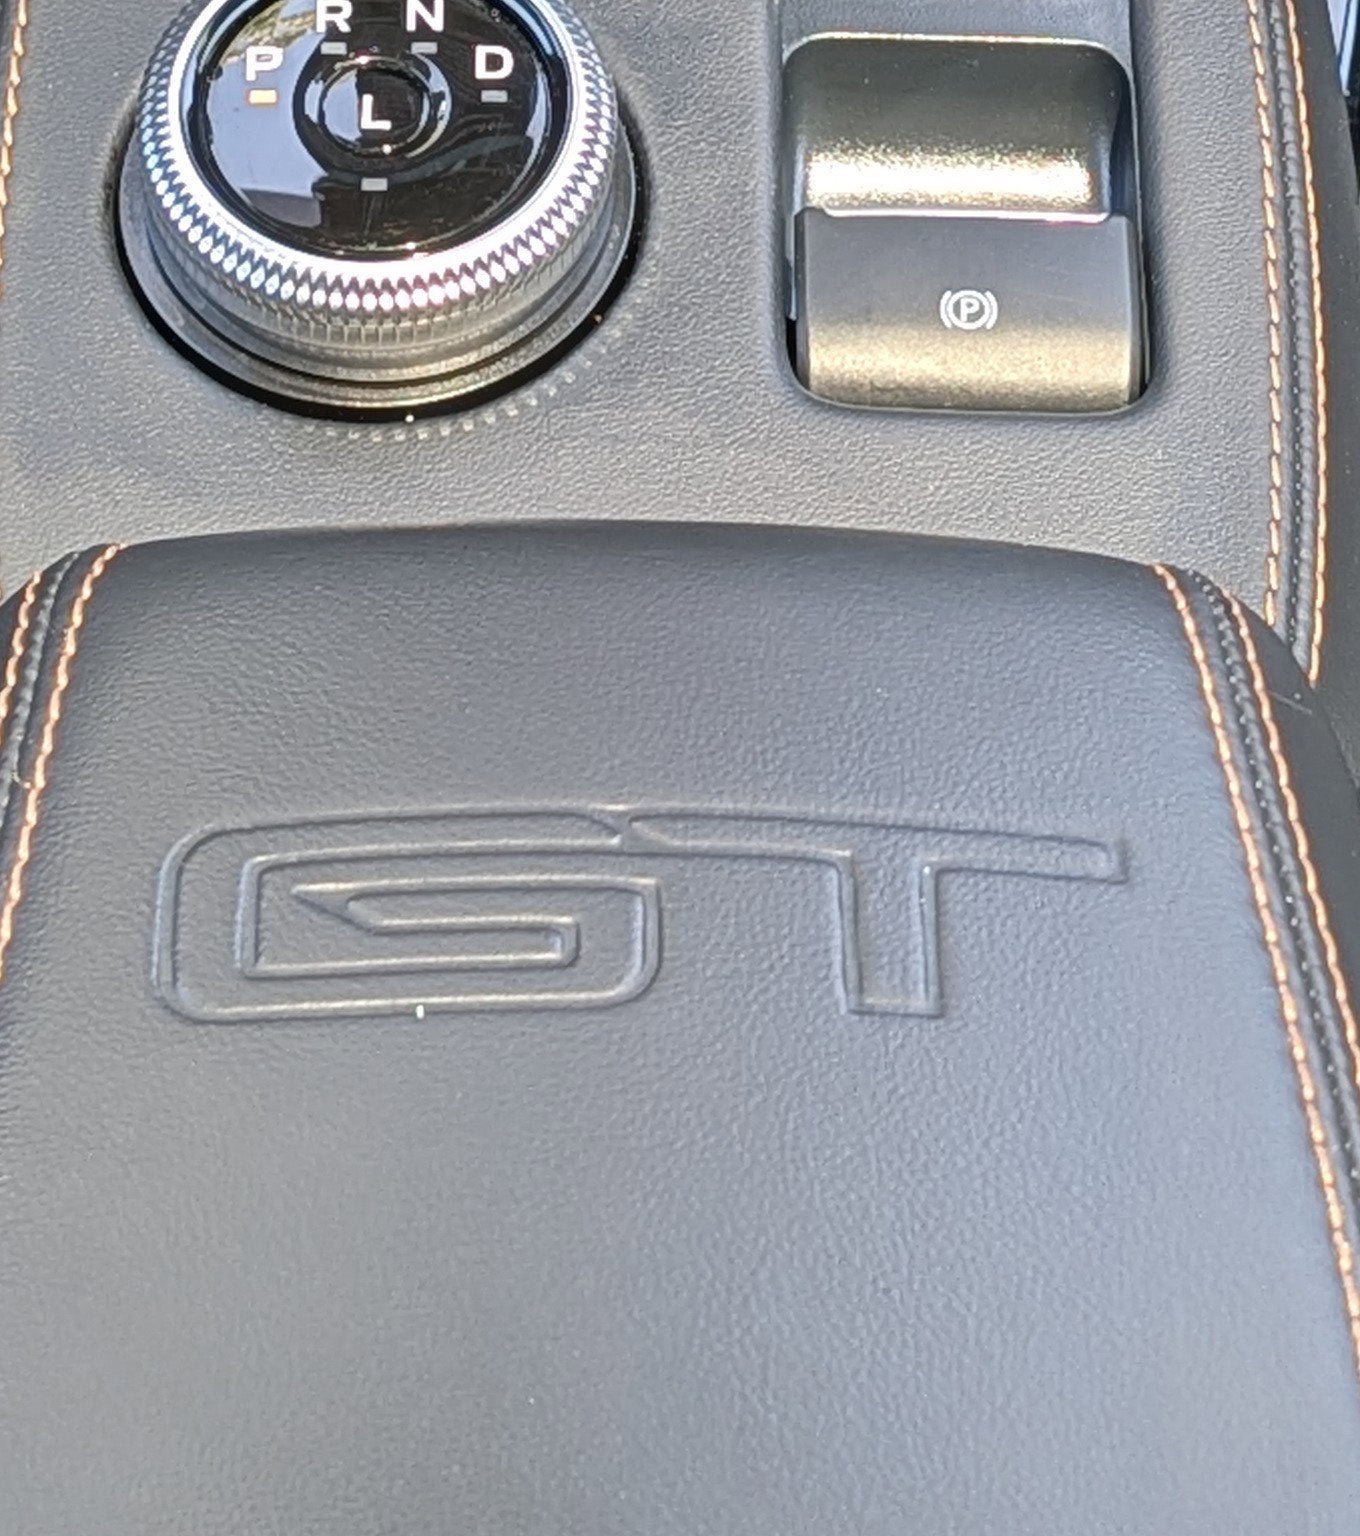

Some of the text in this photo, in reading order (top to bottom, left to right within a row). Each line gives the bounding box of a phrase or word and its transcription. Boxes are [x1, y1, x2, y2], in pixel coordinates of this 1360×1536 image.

[245, 46, 284, 81] P
[475, 45, 514, 80] D
[360, 94, 392, 130] L
[151, 802, 1130, 1023] GT
